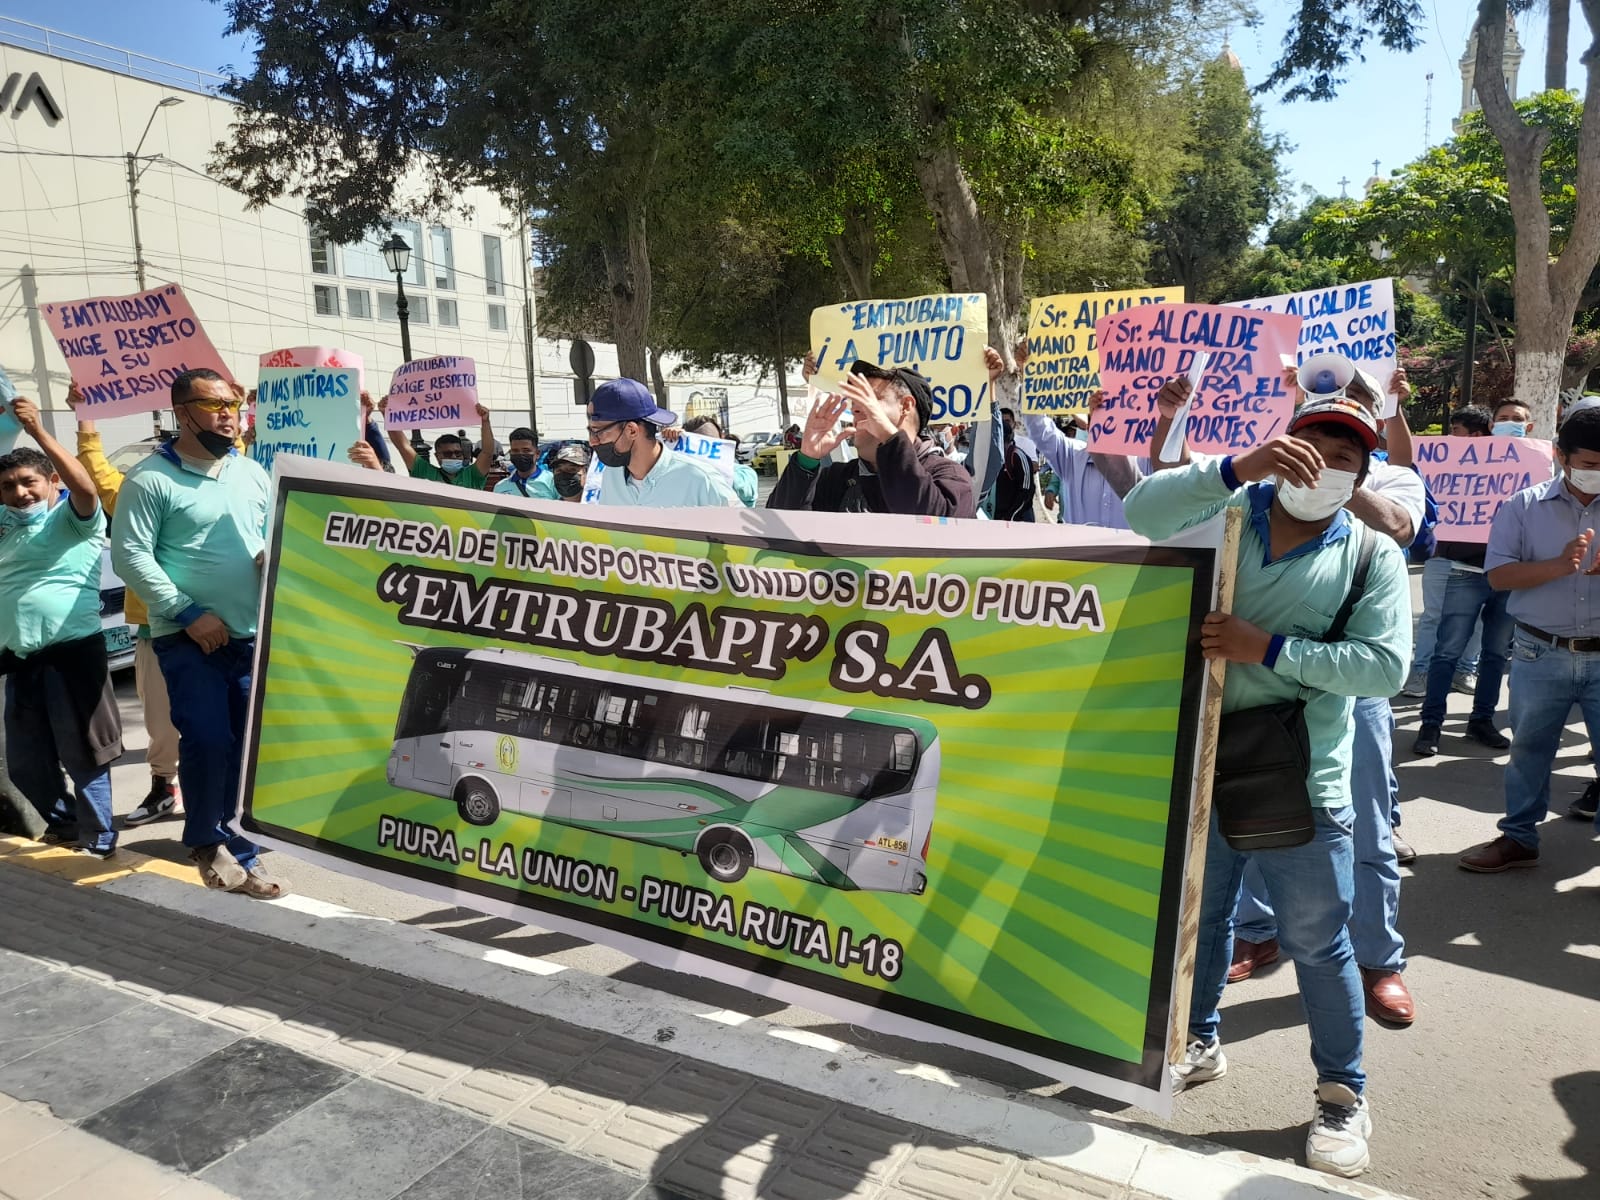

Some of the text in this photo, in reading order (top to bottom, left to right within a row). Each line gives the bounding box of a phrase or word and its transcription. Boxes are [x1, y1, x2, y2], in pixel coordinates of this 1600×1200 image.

[841, 295, 980, 330] "EMTRUBAPI"
[1285, 284, 1372, 321] ALCALDE
[59, 317, 196, 358] EXIGE RESPETO
[1148, 309, 1263, 351] ALCALDE
[1298, 310, 1388, 346] URA CON
[878, 324, 965, 365] PUNTO
[1028, 335, 1075, 357] MANO
[100, 351, 151, 378] A SU
[1025, 355, 1090, 377] CONTRA
[1105, 347, 1166, 374] MANO
[258, 380, 269, 405] NO
[271, 377, 290, 407] MAS
[391, 373, 475, 395] EXIGE RESPETO
[1025, 373, 1101, 395] FUNCIONA
[1132, 374, 1287, 398] CORA EL
[408, 391, 442, 406] A SU
[266, 405, 312, 430] SEÑOR
[1418, 442, 1520, 466] NO A LA
[1425, 472, 1532, 497] MPETENCIA
[325, 514, 1101, 628] EMPRESA DE TRANSPORTES UNIDOS BAJO PIURA
[838, 629, 981, 700] S.A.
[379, 817, 458, 863] PIURA
[479, 841, 516, 876] LA
[524, 850, 616, 899] UNION
[641, 879, 734, 932] PIURA
[742, 904, 829, 960] RUTA
[838, 931, 900, 978] I-18
